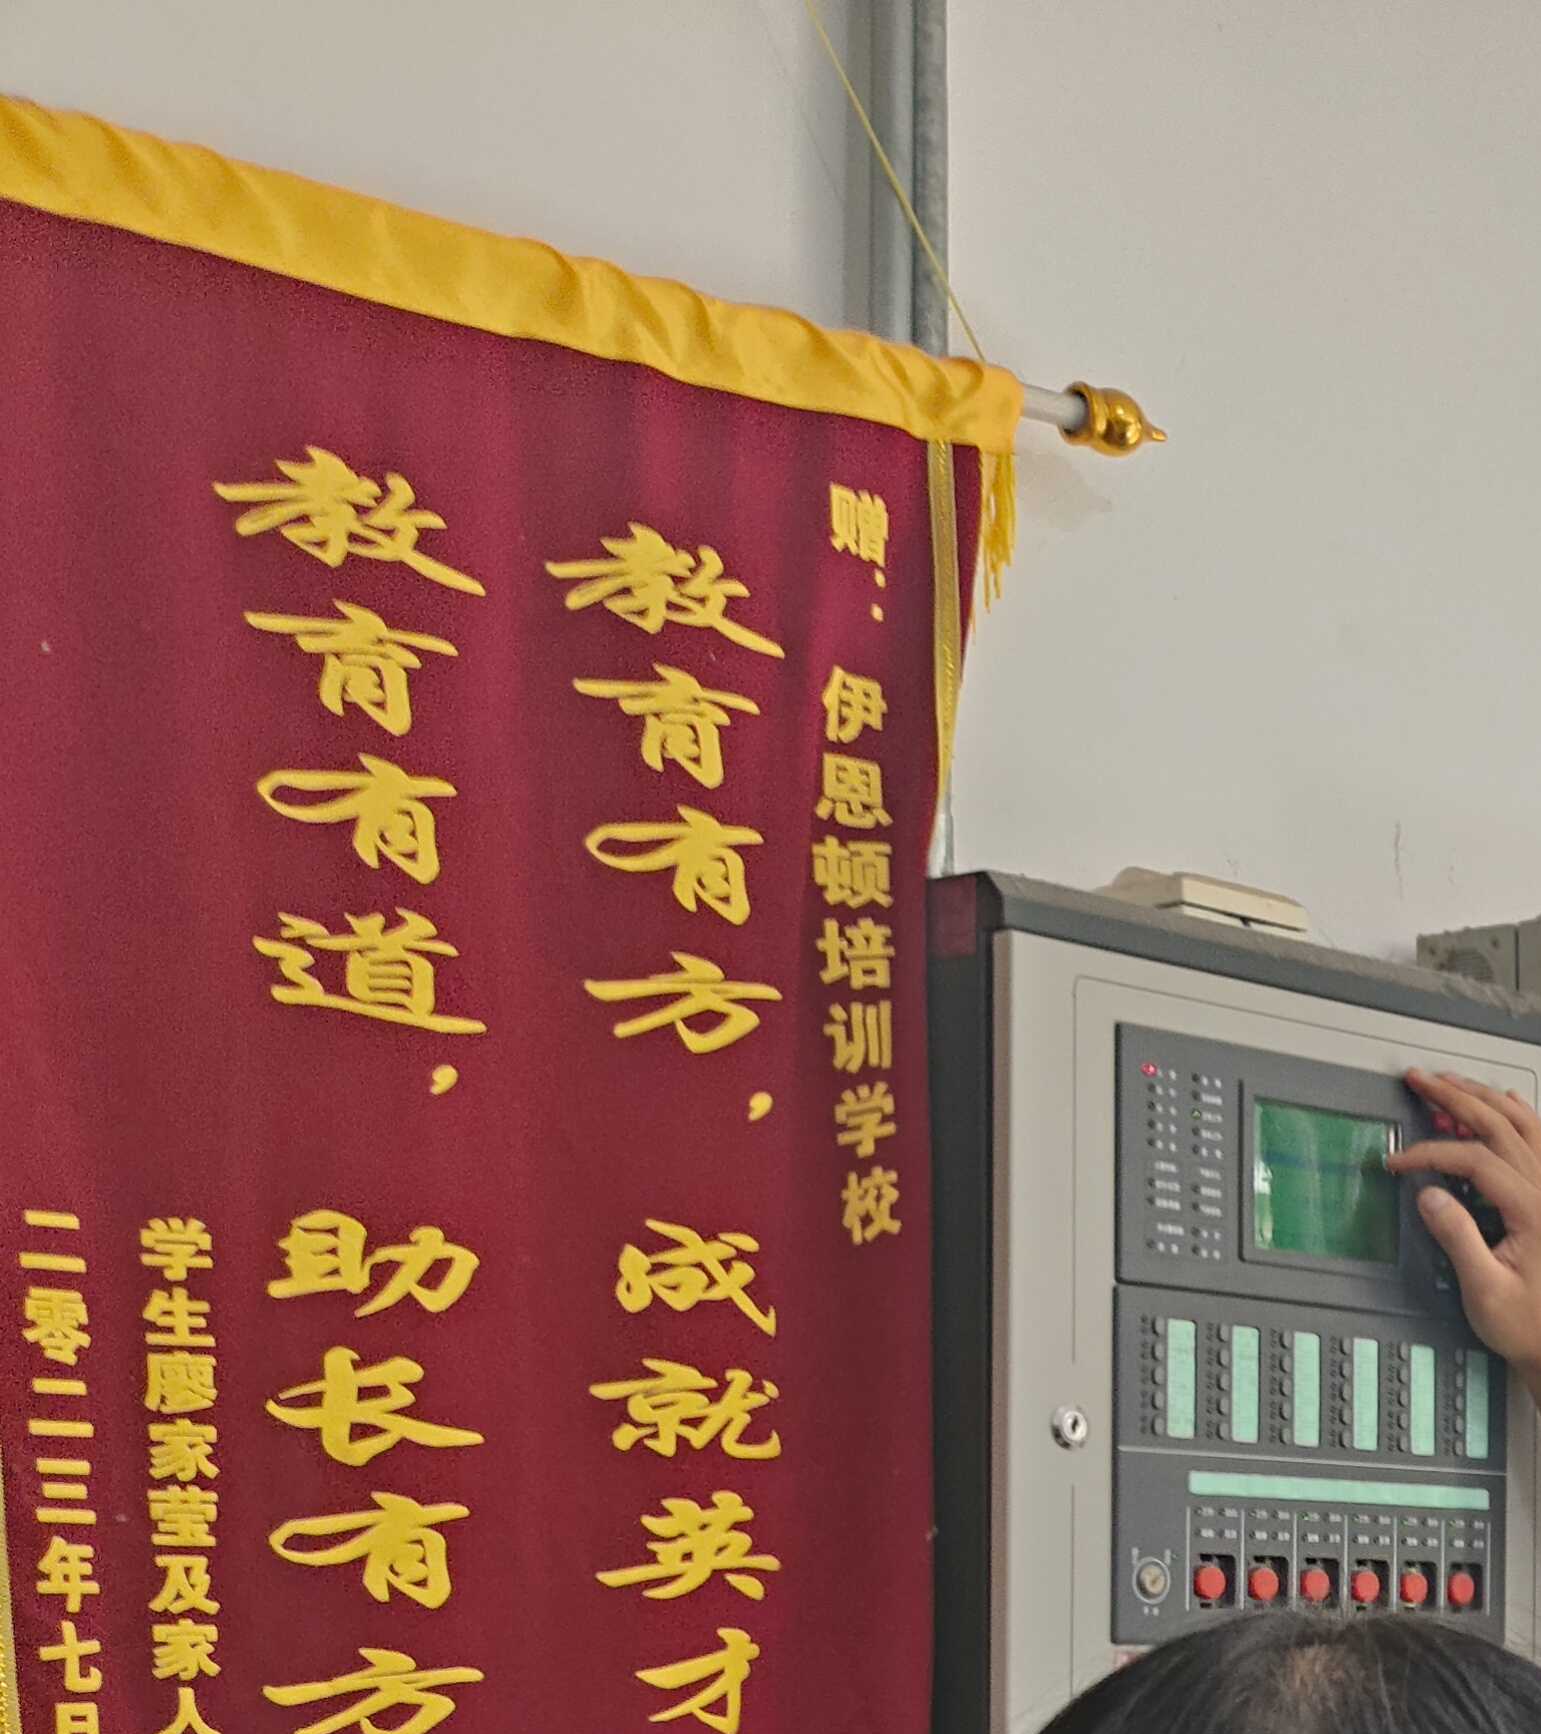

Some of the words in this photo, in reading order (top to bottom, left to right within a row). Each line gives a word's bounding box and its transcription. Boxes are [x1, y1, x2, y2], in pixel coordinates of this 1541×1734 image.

[812, 484, 903, 1246] 赠：伊恩顿培训学校
